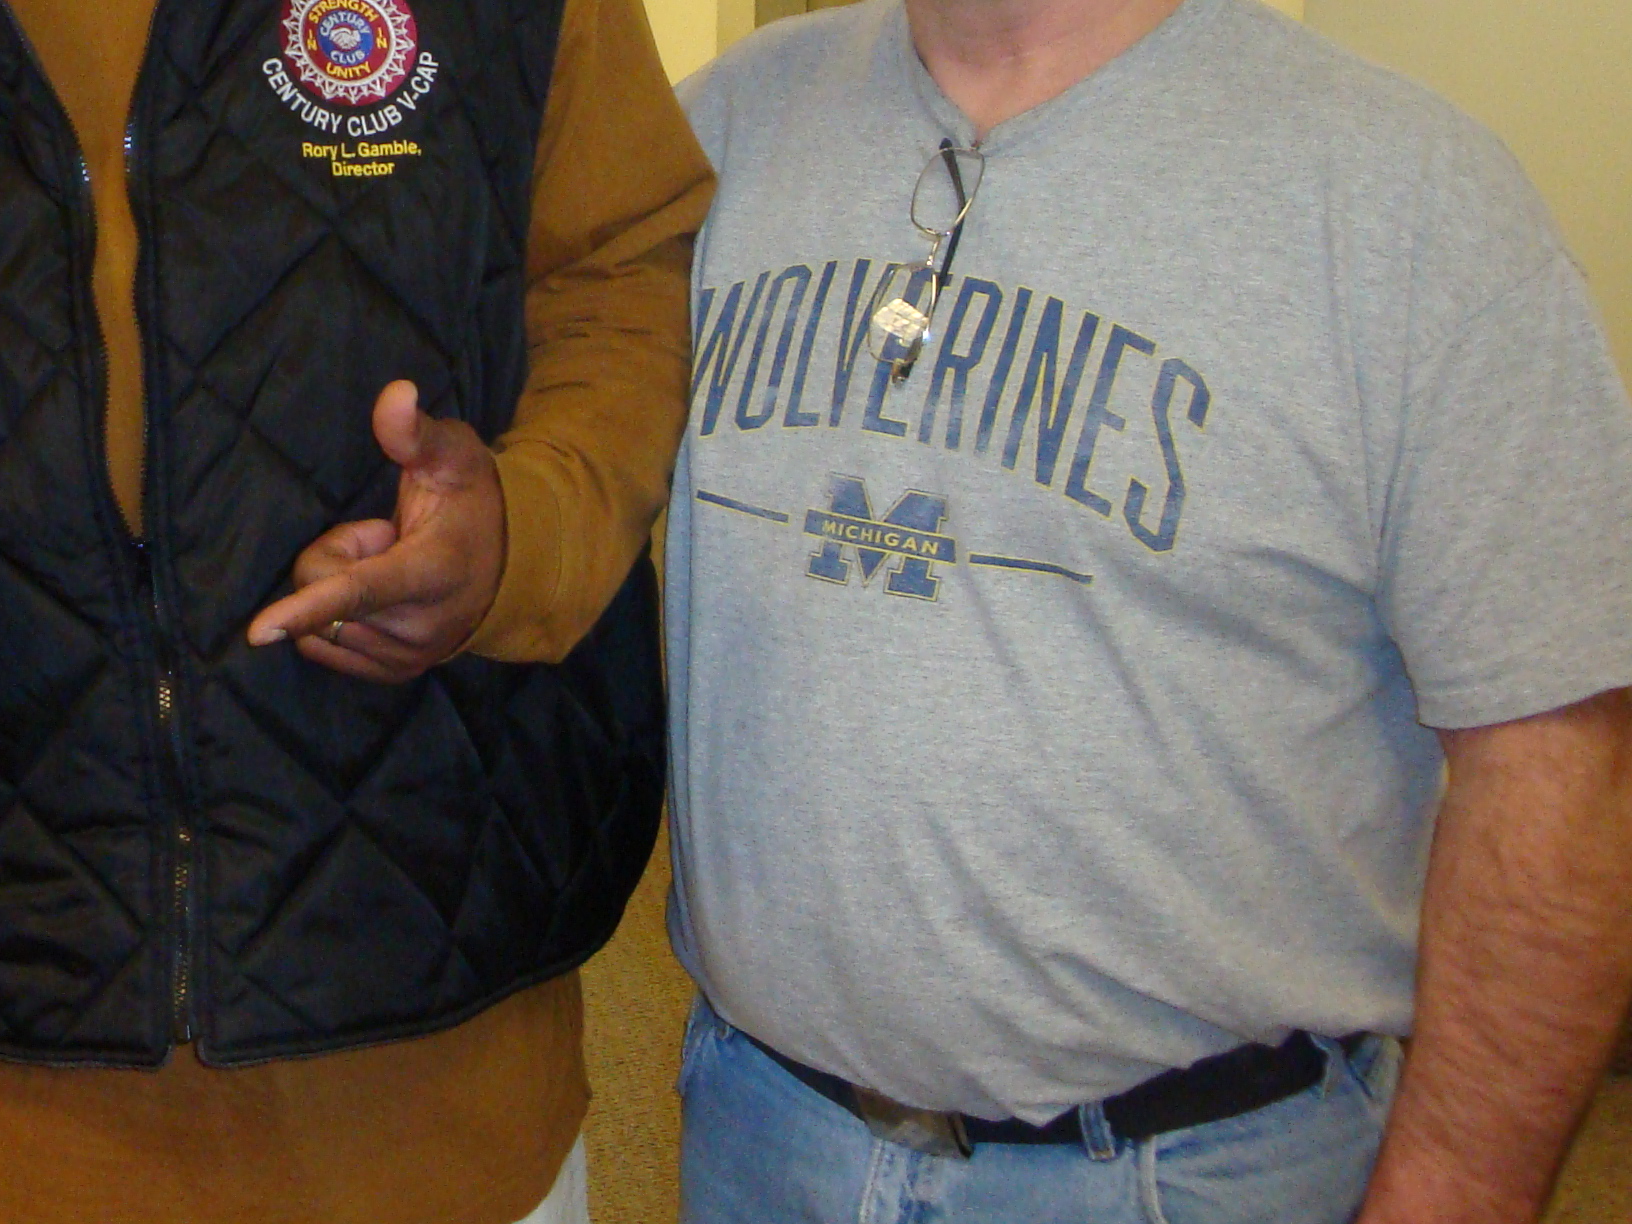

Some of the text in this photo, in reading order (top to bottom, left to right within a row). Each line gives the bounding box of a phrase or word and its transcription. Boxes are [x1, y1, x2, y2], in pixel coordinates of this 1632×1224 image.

[320, 11, 371, 36] CENTURY
[307, 29, 317, 51] IN
[376, 27, 388, 49] IN
[330, 50, 366, 64] CLUB
[325, 61, 371, 79] UNITY
[262, 51, 439, 137] CENTURY CLUB V-CAP
[301, 142, 338, 160] Rory
[341, 143, 355, 158] L.
[332, 161, 395, 176] Director
[691, 258, 1210, 554] WOLVERINES
[821, 519, 939, 555] MICHIGAN
